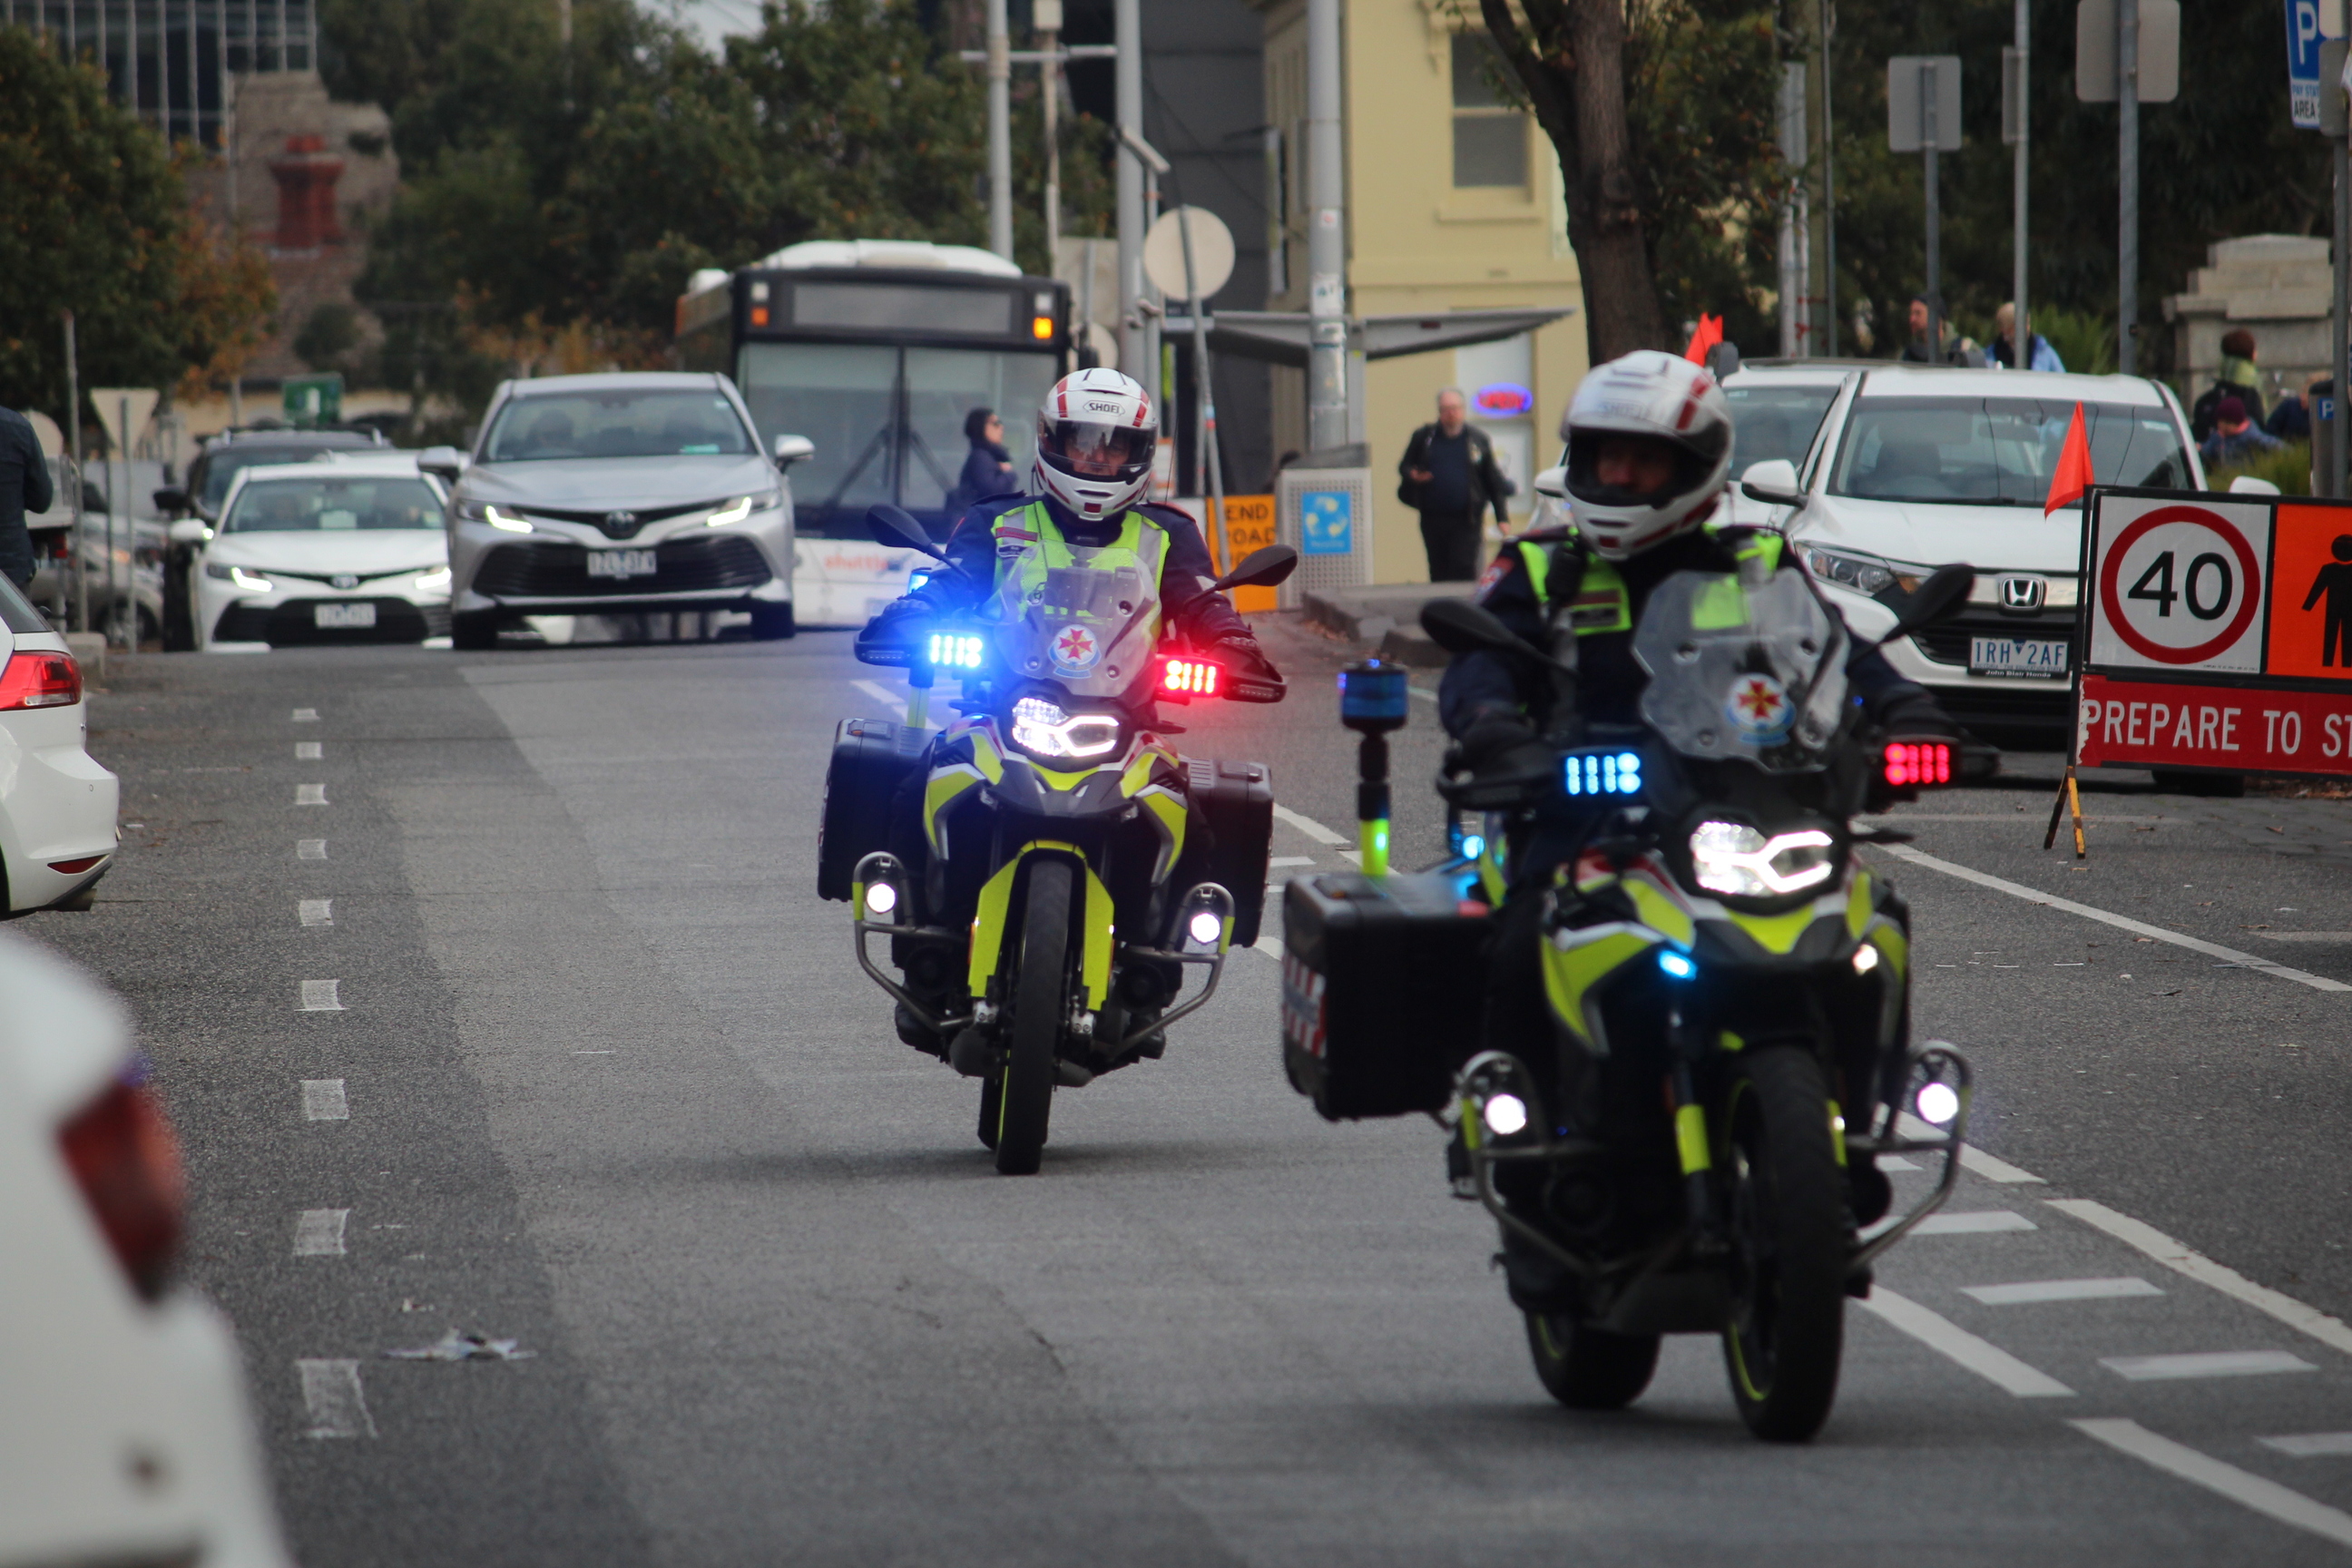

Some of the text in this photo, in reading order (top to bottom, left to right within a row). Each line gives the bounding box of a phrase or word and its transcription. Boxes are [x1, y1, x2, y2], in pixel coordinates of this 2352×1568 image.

[2296, 1, 2317, 64] P
[2294, 100, 2316, 119] AREA
[1089, 402, 1120, 414] SHOEI
[2322, 401, 2334, 418] P
[1226, 504, 1269, 521] END
[1226, 528, 1276, 545] OAD
[2127, 550, 2233, 621] 40
[1975, 641, 2065, 665] 1RH 2AF
[2082, 699, 2241, 751] PREPARE
[2262, 710, 2301, 755] TO
